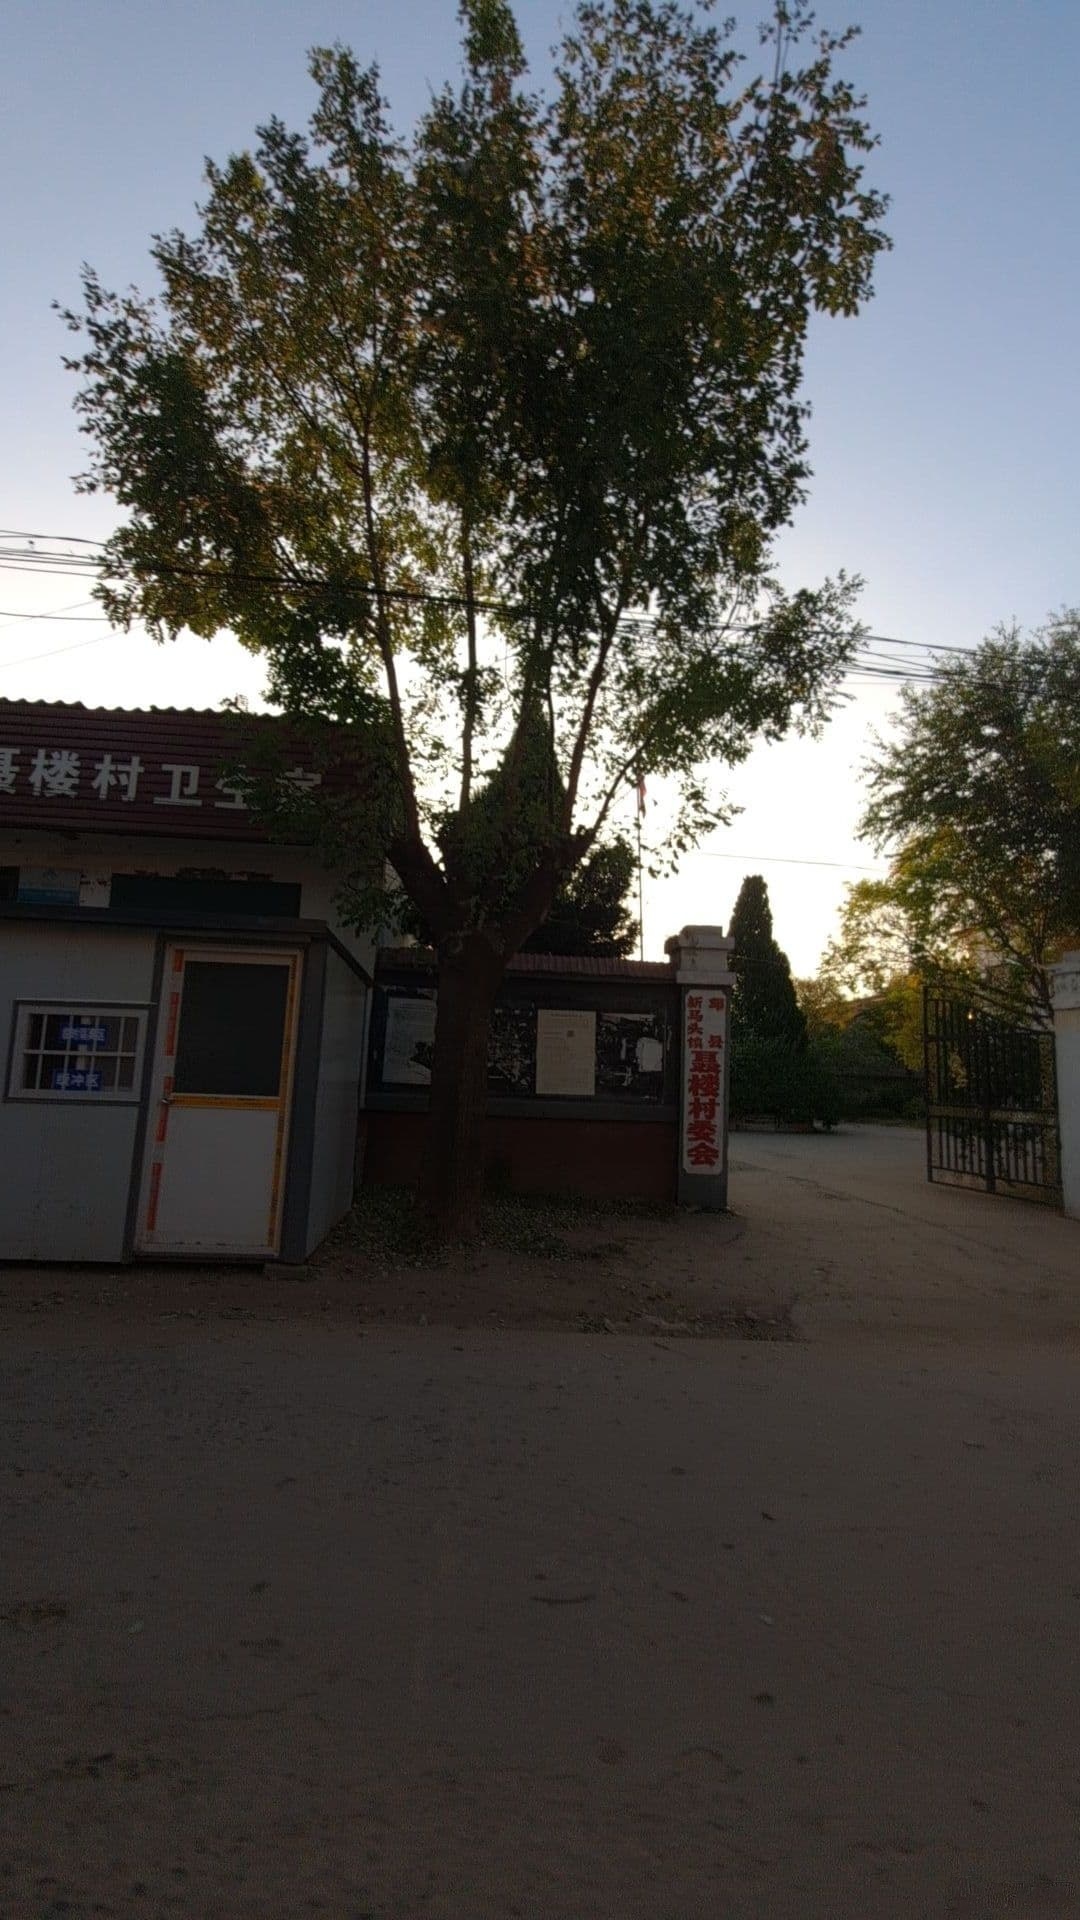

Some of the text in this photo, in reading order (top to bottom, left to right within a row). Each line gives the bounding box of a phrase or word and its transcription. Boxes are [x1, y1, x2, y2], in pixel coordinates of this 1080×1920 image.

[686, 1050, 721, 1166] 聂楼村委会
